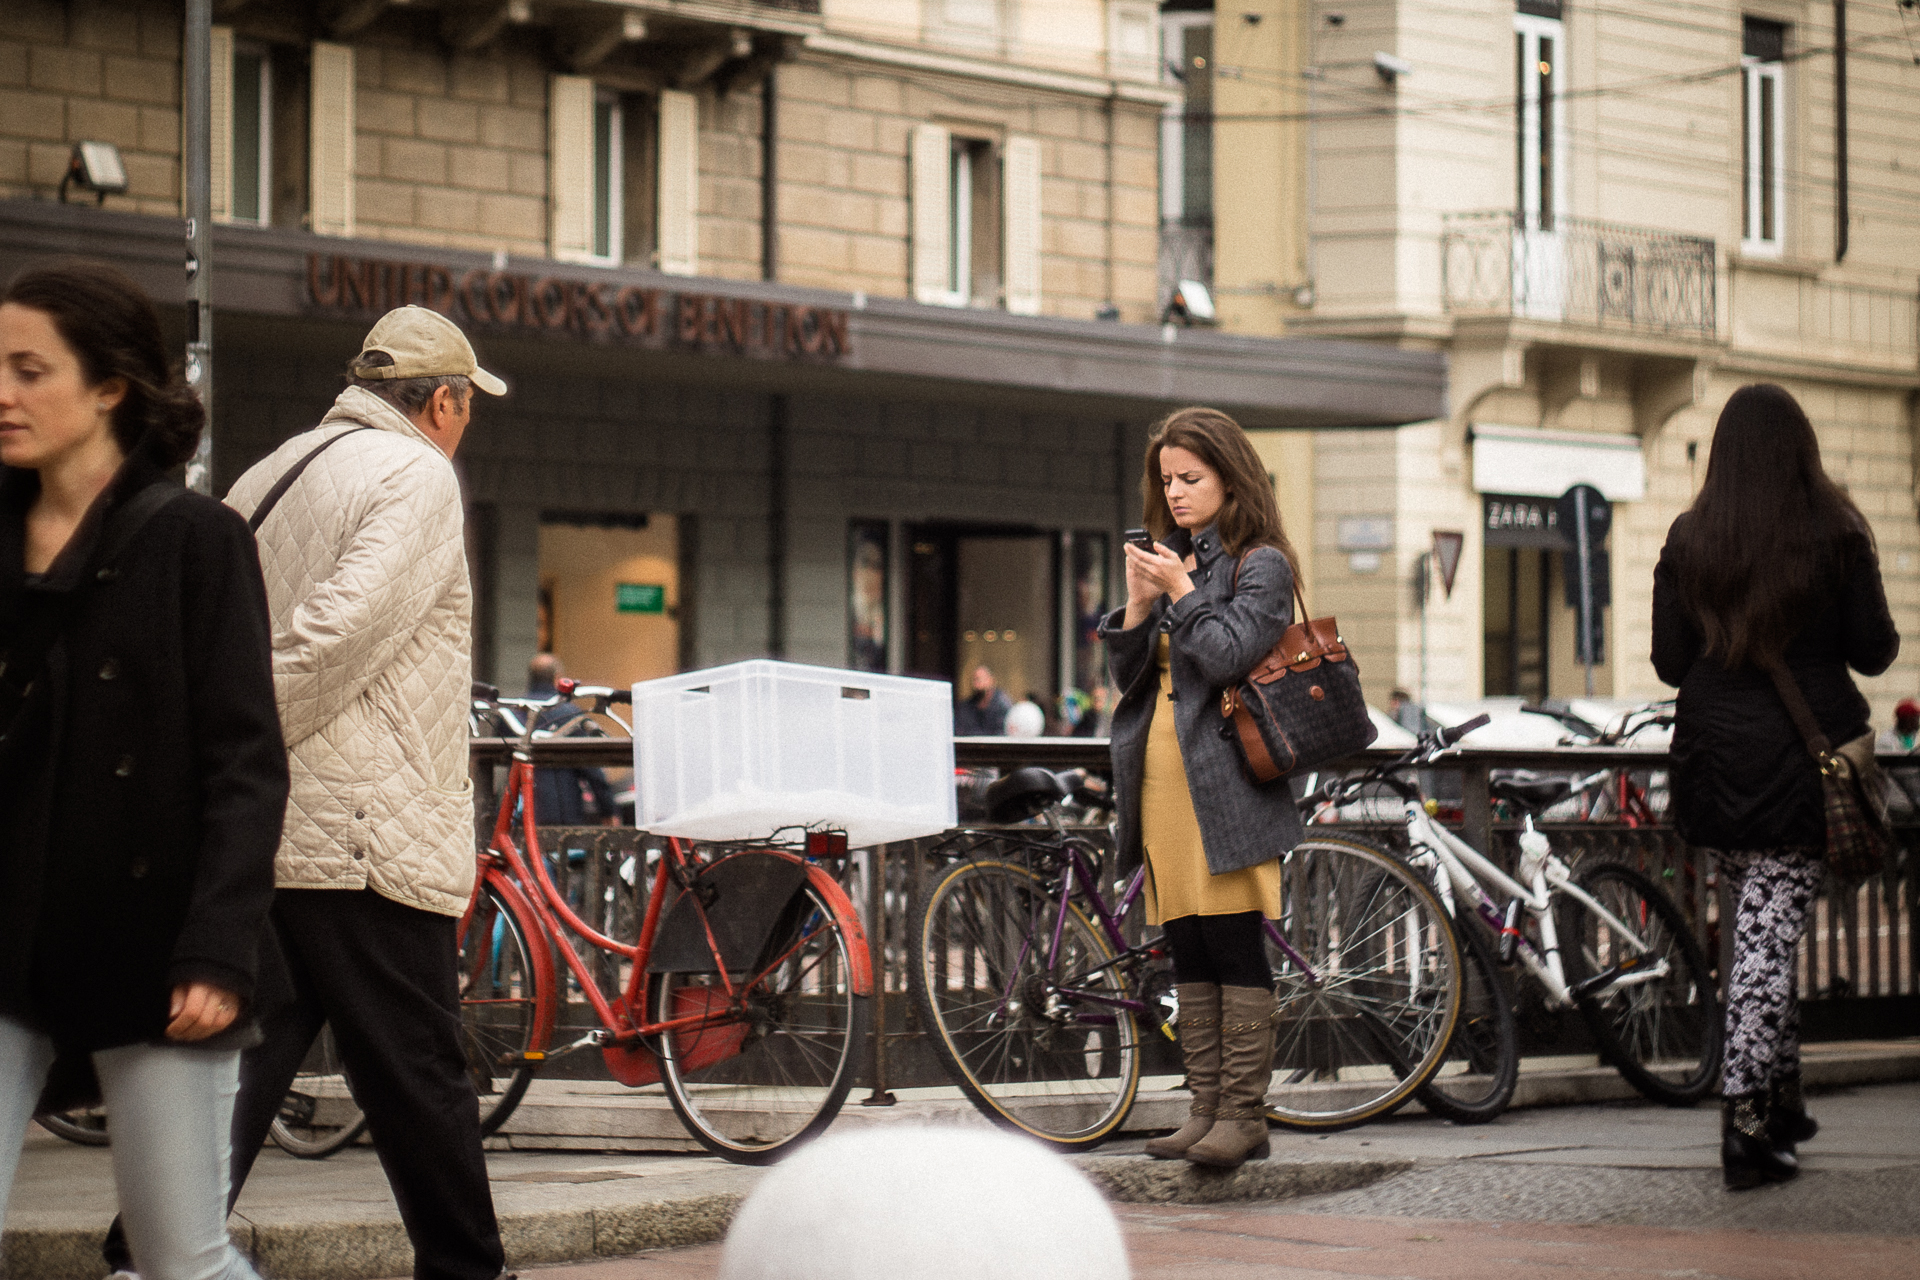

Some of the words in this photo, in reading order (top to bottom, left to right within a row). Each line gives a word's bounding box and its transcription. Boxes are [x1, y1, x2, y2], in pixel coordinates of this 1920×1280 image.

[306, 251, 453, 316] UNITED
[460, 267, 611, 335] COLORS
[616, 284, 663, 338] OF
[676, 291, 852, 358] BENETTON
[1488, 501, 1544, 530] ZARA
